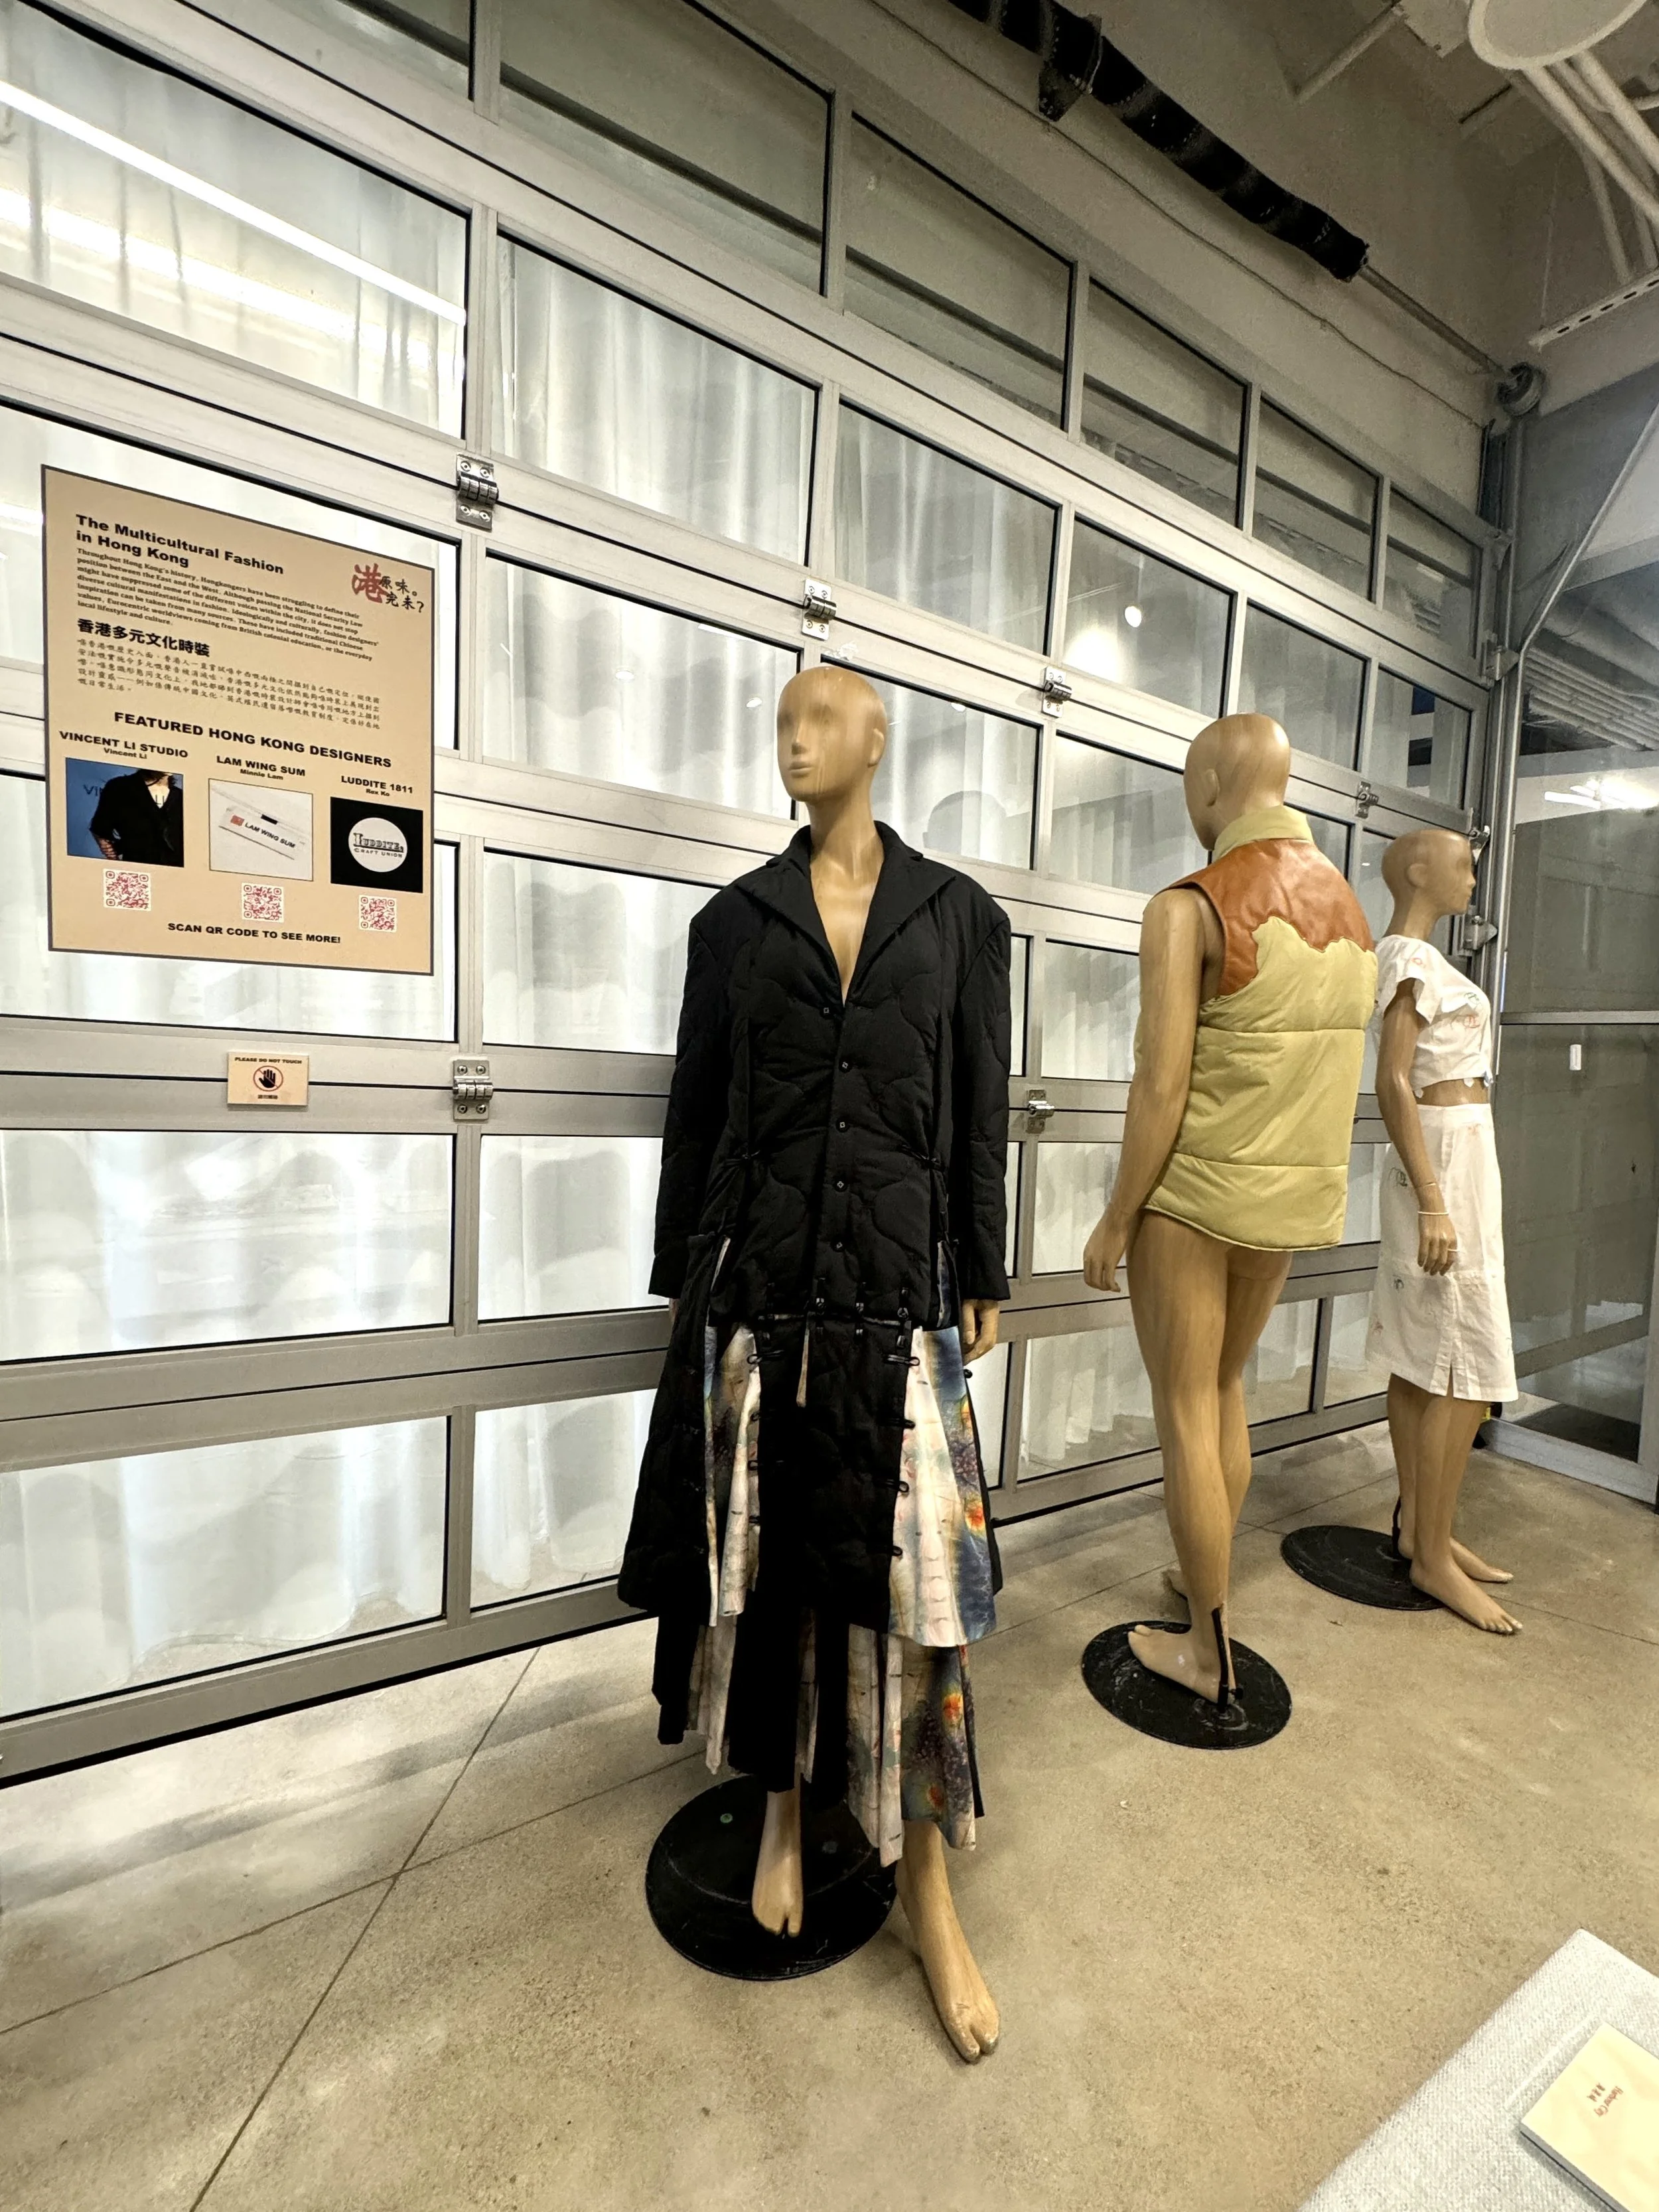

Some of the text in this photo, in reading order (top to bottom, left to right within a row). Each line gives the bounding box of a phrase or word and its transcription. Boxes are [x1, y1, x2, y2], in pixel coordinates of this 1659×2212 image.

[76, 514, 283, 574] The Multicultural Fashion
[76, 530, 188, 568] in Hong Kong
[76, 548, 121, 563] Throughout
[122, 557, 143, 569] Hong
[200, 576, 246, 592] Hongkongers
[246, 587, 263, 596] have
[264, 591, 280, 600] been
[281, 597, 315, 609] struggling
[323, 606, 343, 615] define
[76, 557, 108, 568] position
[108, 563, 141, 576] between
[155, 574, 171, 583] East
[223, 590, 254, 602] Although
[255, 599, 281, 609] passing
[294, 607, 322, 618] National
[323, 613, 348, 625] Security
[76, 566, 100, 575] might
[101, 570, 119, 579] have
[120, 575, 161, 589] suppressed
[161, 585, 182, 594] some
[204, 594, 236, 606] different
[236, 602, 258, 611] voices
[258, 607, 281, 617] within
[352, 563, 390, 603] 港
[76, 574, 105, 585] diverse
[106, 581, 135, 592] cultural
[137, 588, 191, 604] manifestations
[323, 629, 346, 639] fashion
[77, 618, 209, 657] 香港多元文化時裝
[58, 731, 188, 757] VINCENT LI STUDIO
[103, 747, 137, 757] Vincent
[114, 711, 391, 767] FEATURED HONG KONG DESIGNERS
[216, 755, 305, 776] LAM WING SUM
[240, 768, 265, 777] Minnie
[341, 775, 412, 793] LUDDITE 1811
[245, 822, 296, 848] LAM WING SUM
[167, 922, 202, 932] SCAN
[226, 927, 259, 937] CODE
[261, 930, 277, 938] TO
[281, 932, 303, 940] SEE
[305, 934, 340, 943] MORE!
